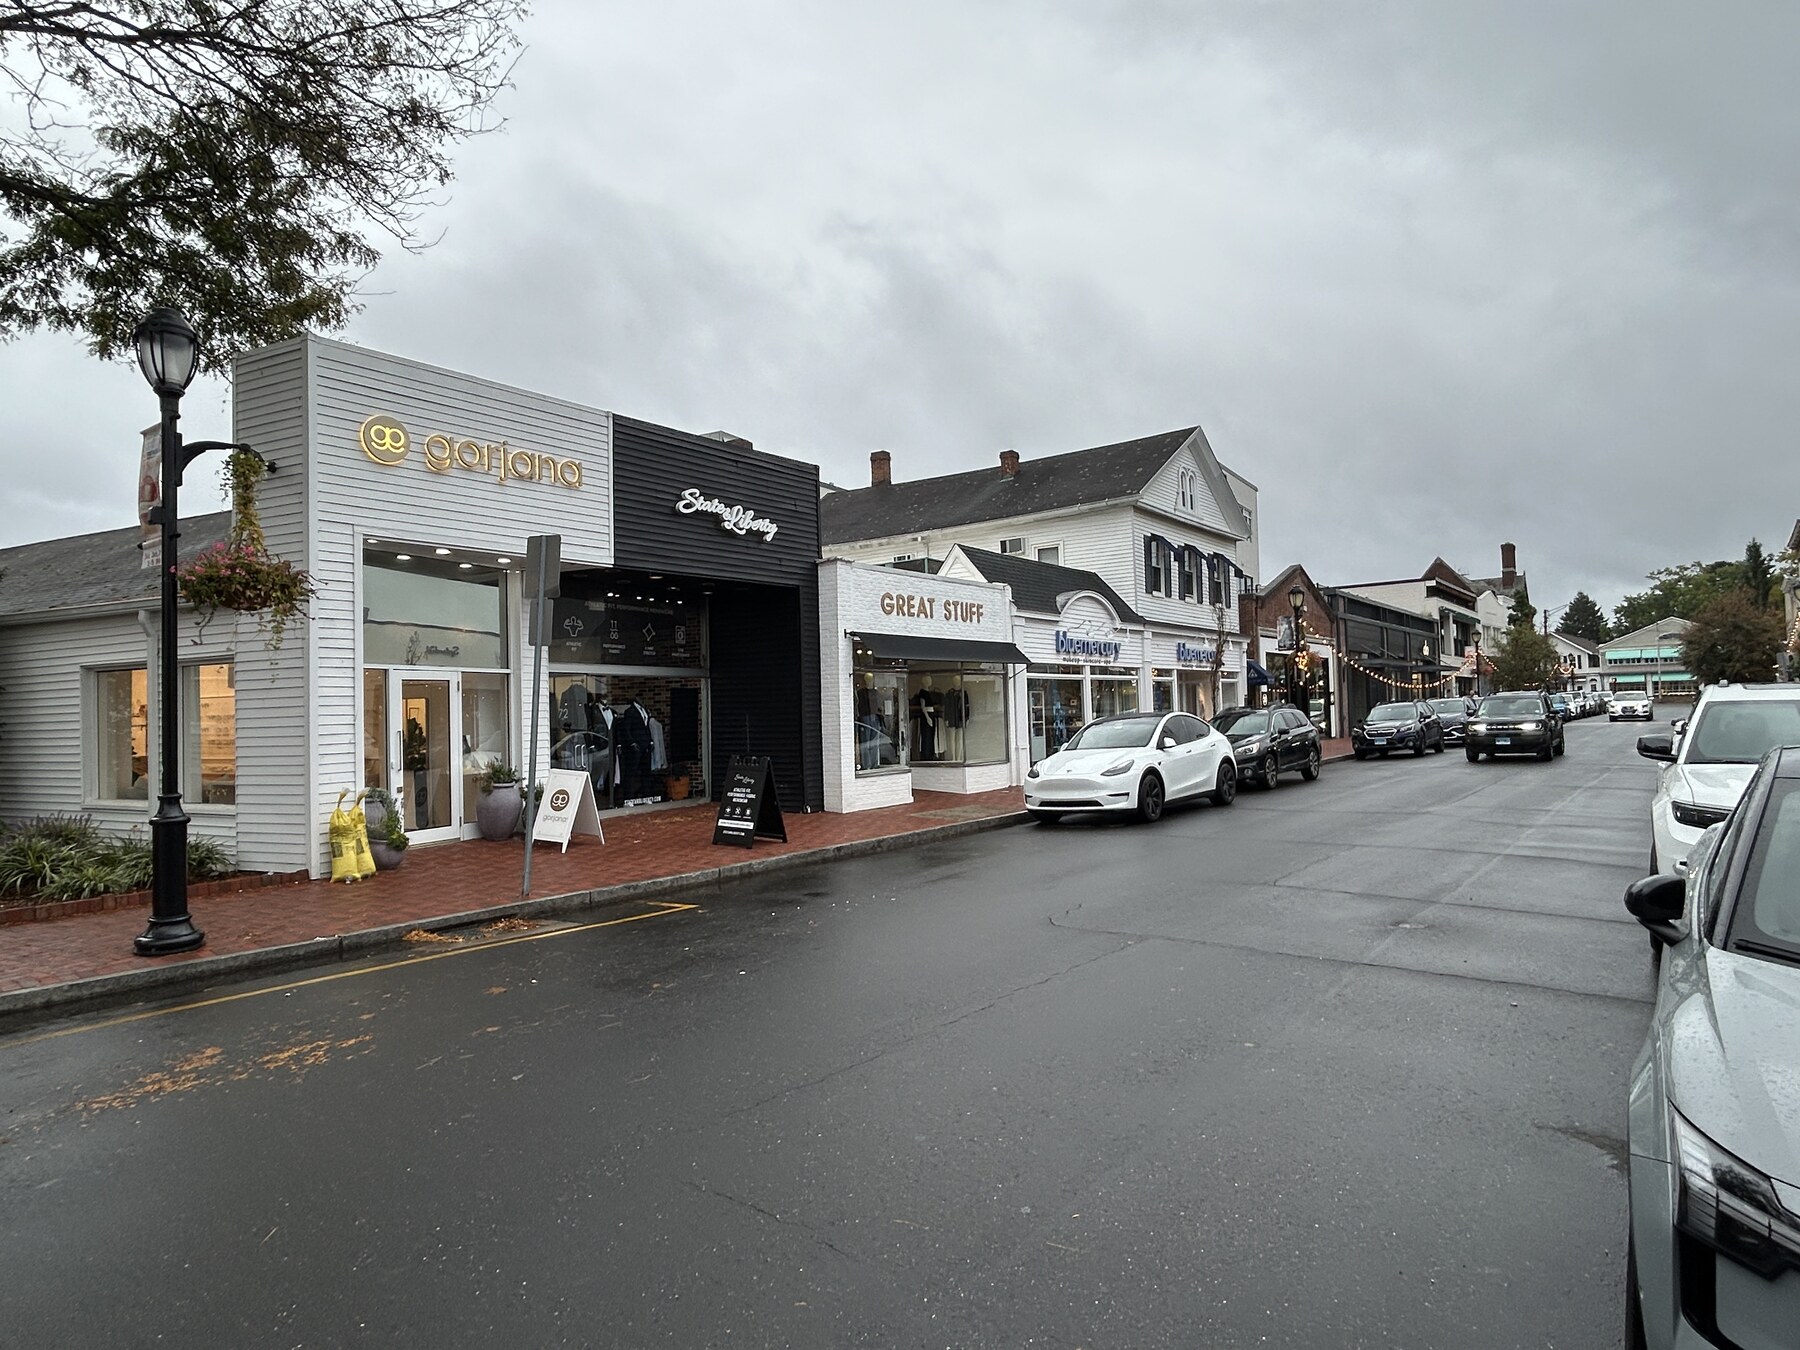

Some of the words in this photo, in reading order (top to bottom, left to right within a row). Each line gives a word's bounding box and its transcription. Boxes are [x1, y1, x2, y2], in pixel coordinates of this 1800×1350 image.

[425, 433, 583, 488] gorjana
[675, 488, 725, 514] State
[721, 505, 778, 542] Liberty
[880, 592, 935, 619] GREAT
[943, 600, 984, 624] STUFF
[1055, 630, 1122, 662] bluemercury
[542, 814, 567, 823] gorjana
